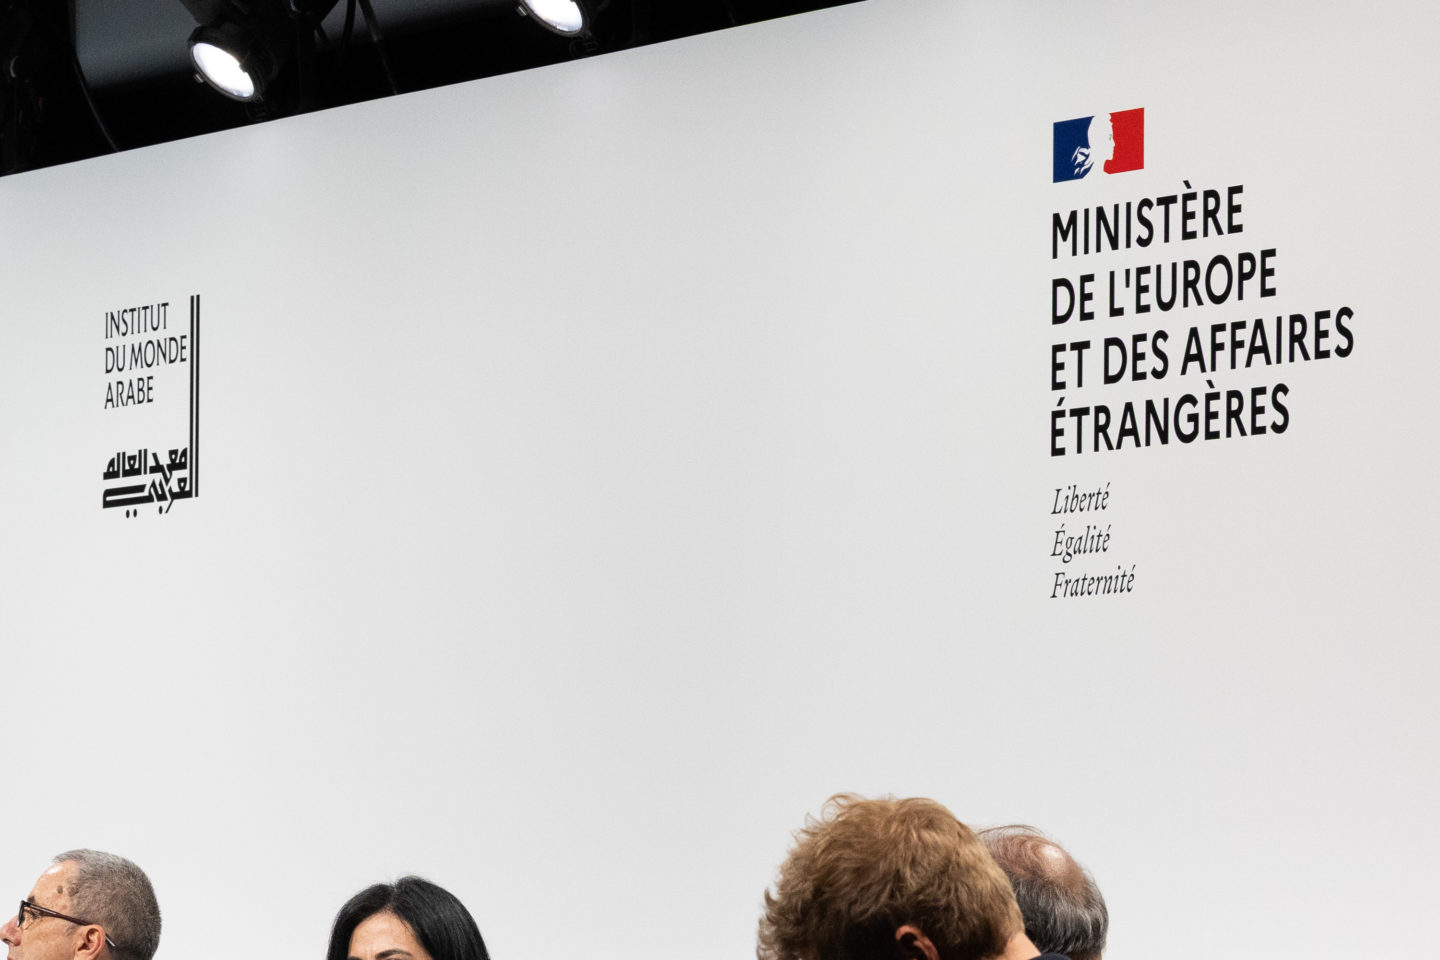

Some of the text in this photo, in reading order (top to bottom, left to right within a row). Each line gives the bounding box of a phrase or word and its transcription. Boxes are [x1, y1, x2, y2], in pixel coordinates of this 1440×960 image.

[1051, 179, 1245, 260] MINISTÈRE
[1051, 247, 1278, 326] DE L'EUROPE
[104, 301, 170, 340] INSTITUT
[104, 334, 188, 375] DU MONDE
[1050, 306, 1355, 392] ET DES AFFAIRES
[103, 375, 155, 410] ARABE
[1050, 379, 1291, 458] ÉTRANGÈRES
[1050, 481, 1111, 516] Liberté
[1049, 522, 1111, 564] Égalité
[1049, 564, 1136, 600] Fraternité
